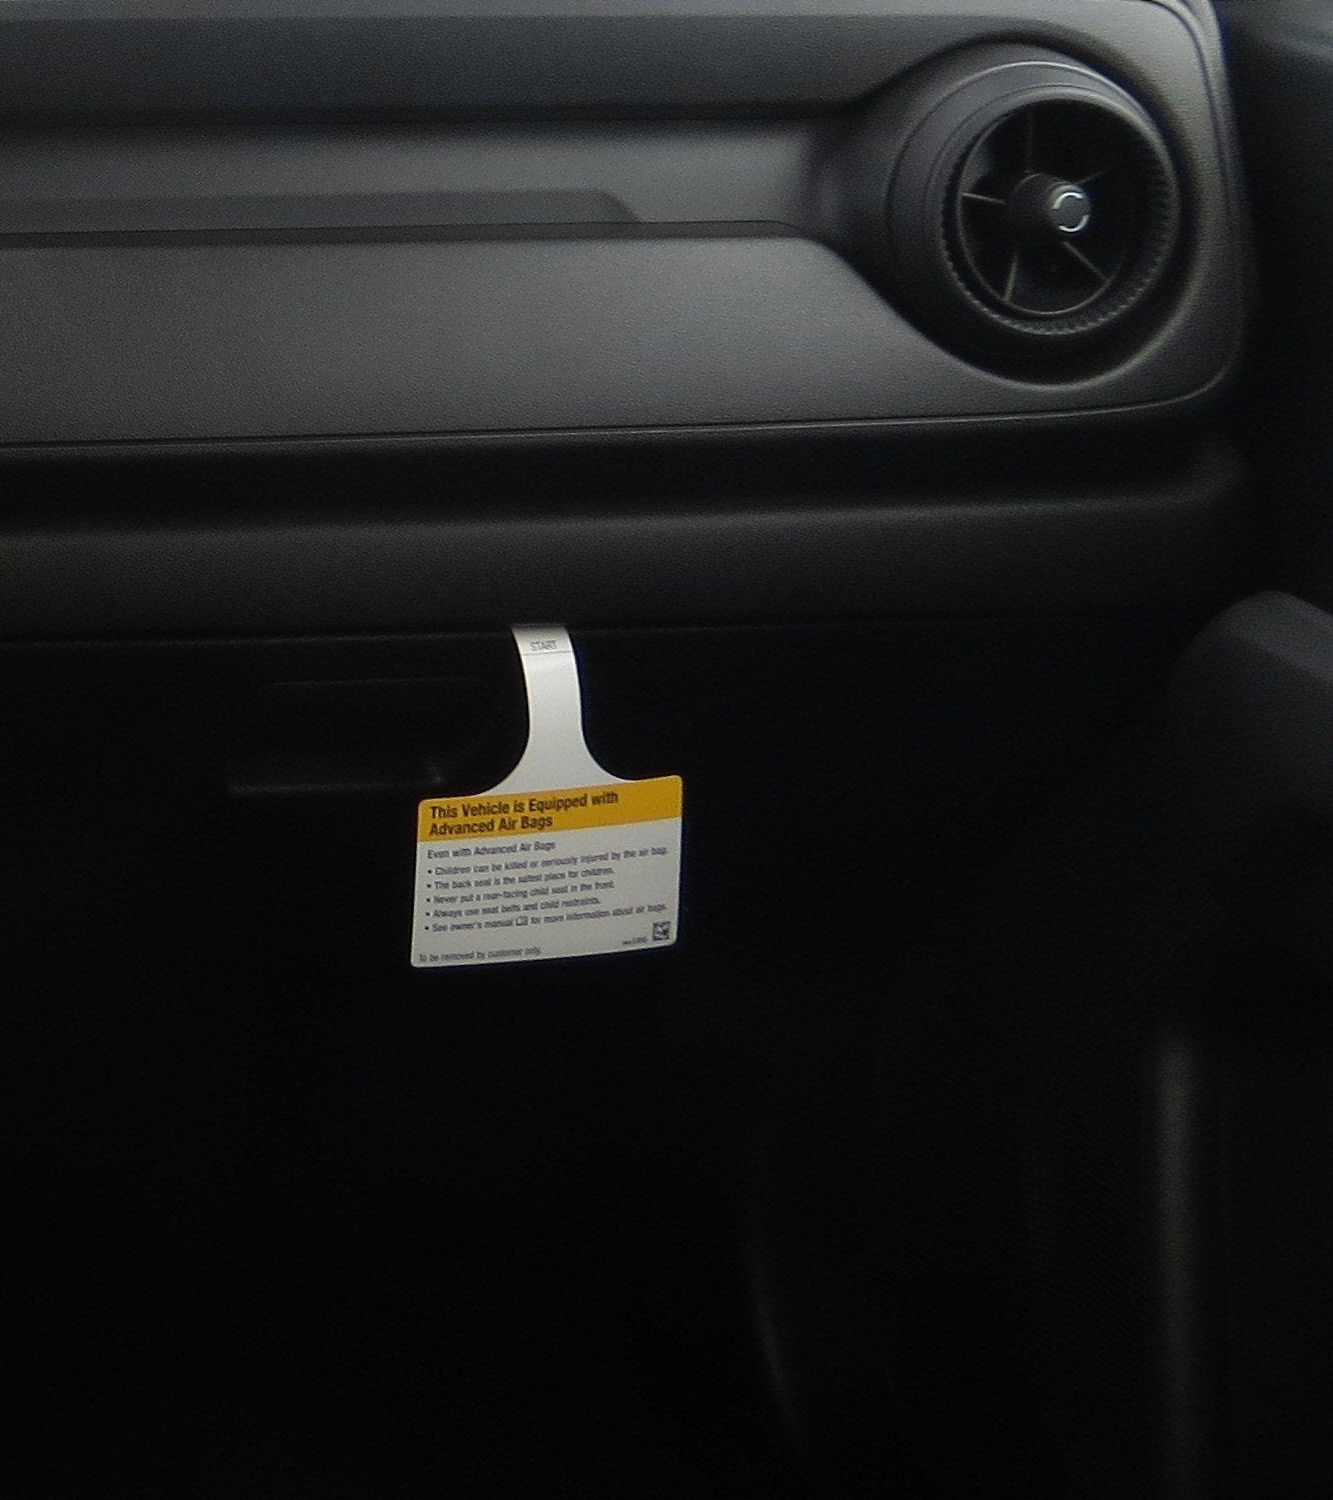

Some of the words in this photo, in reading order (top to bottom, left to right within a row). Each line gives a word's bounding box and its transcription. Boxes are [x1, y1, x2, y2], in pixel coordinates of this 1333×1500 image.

[430, 805, 458, 819] This
[462, 801, 511, 817] Vehicle
[513, 800, 525, 813] is
[528, 793, 588, 813] Equipped
[591, 791, 619, 805] with
[429, 819, 495, 836] Advanced
[498, 817, 518, 831] Air
[520, 816, 553, 830] Bags
